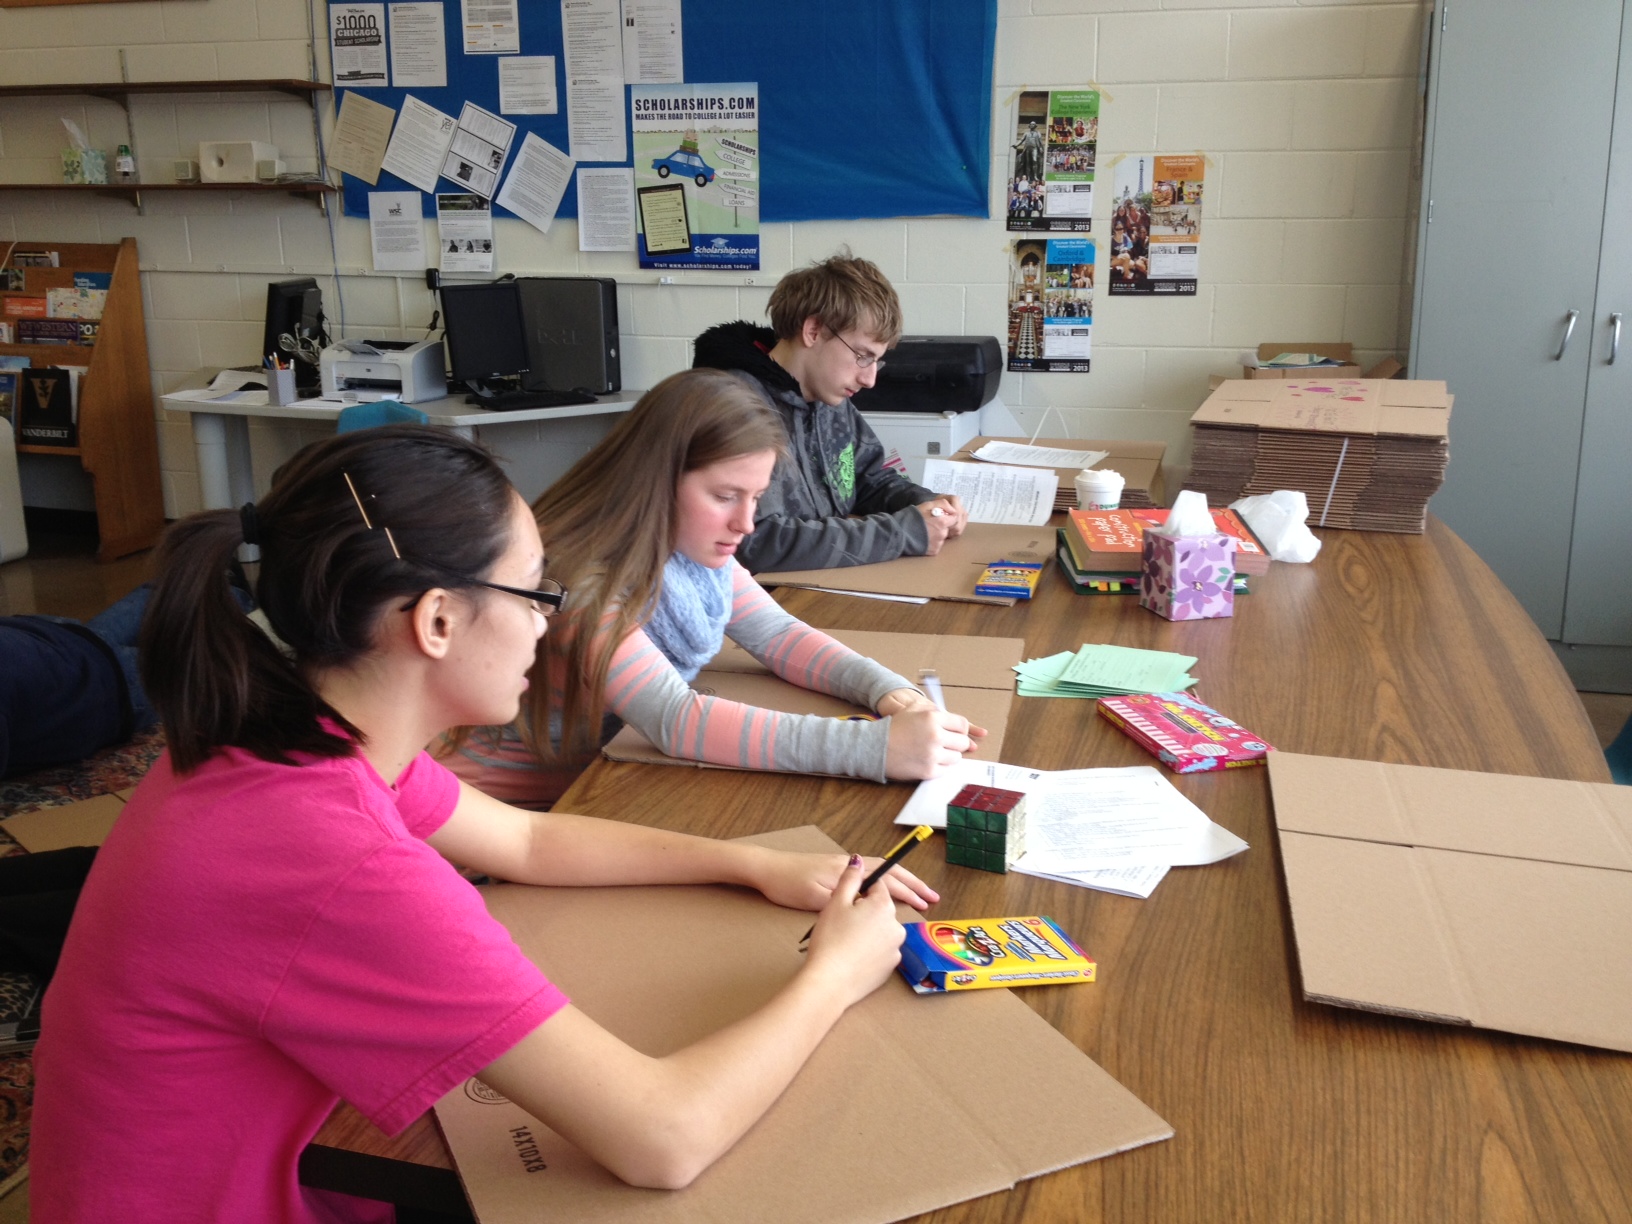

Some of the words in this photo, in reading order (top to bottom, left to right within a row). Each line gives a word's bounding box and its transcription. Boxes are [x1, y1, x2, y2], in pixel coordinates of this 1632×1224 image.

[336, 14, 376, 29] $1000
[337, 28, 377, 37] CHICAGO
[635, 97, 755, 111] SCHOLARSHIPS.COM
[635, 113, 655, 121] MAKES
[693, 112, 717, 120] COLLEGE
[723, 112, 734, 120] LOT
[735, 111, 755, 119] EASIER
[721, 138, 756, 156] SCHOLARSHIPS
[723, 153, 746, 166] COLLEGE
[722, 170, 751, 178] ADMISSIONS
[693, 245, 758, 255] Scholarships.com
[22, 428, 68, 438] VANDERBILT
